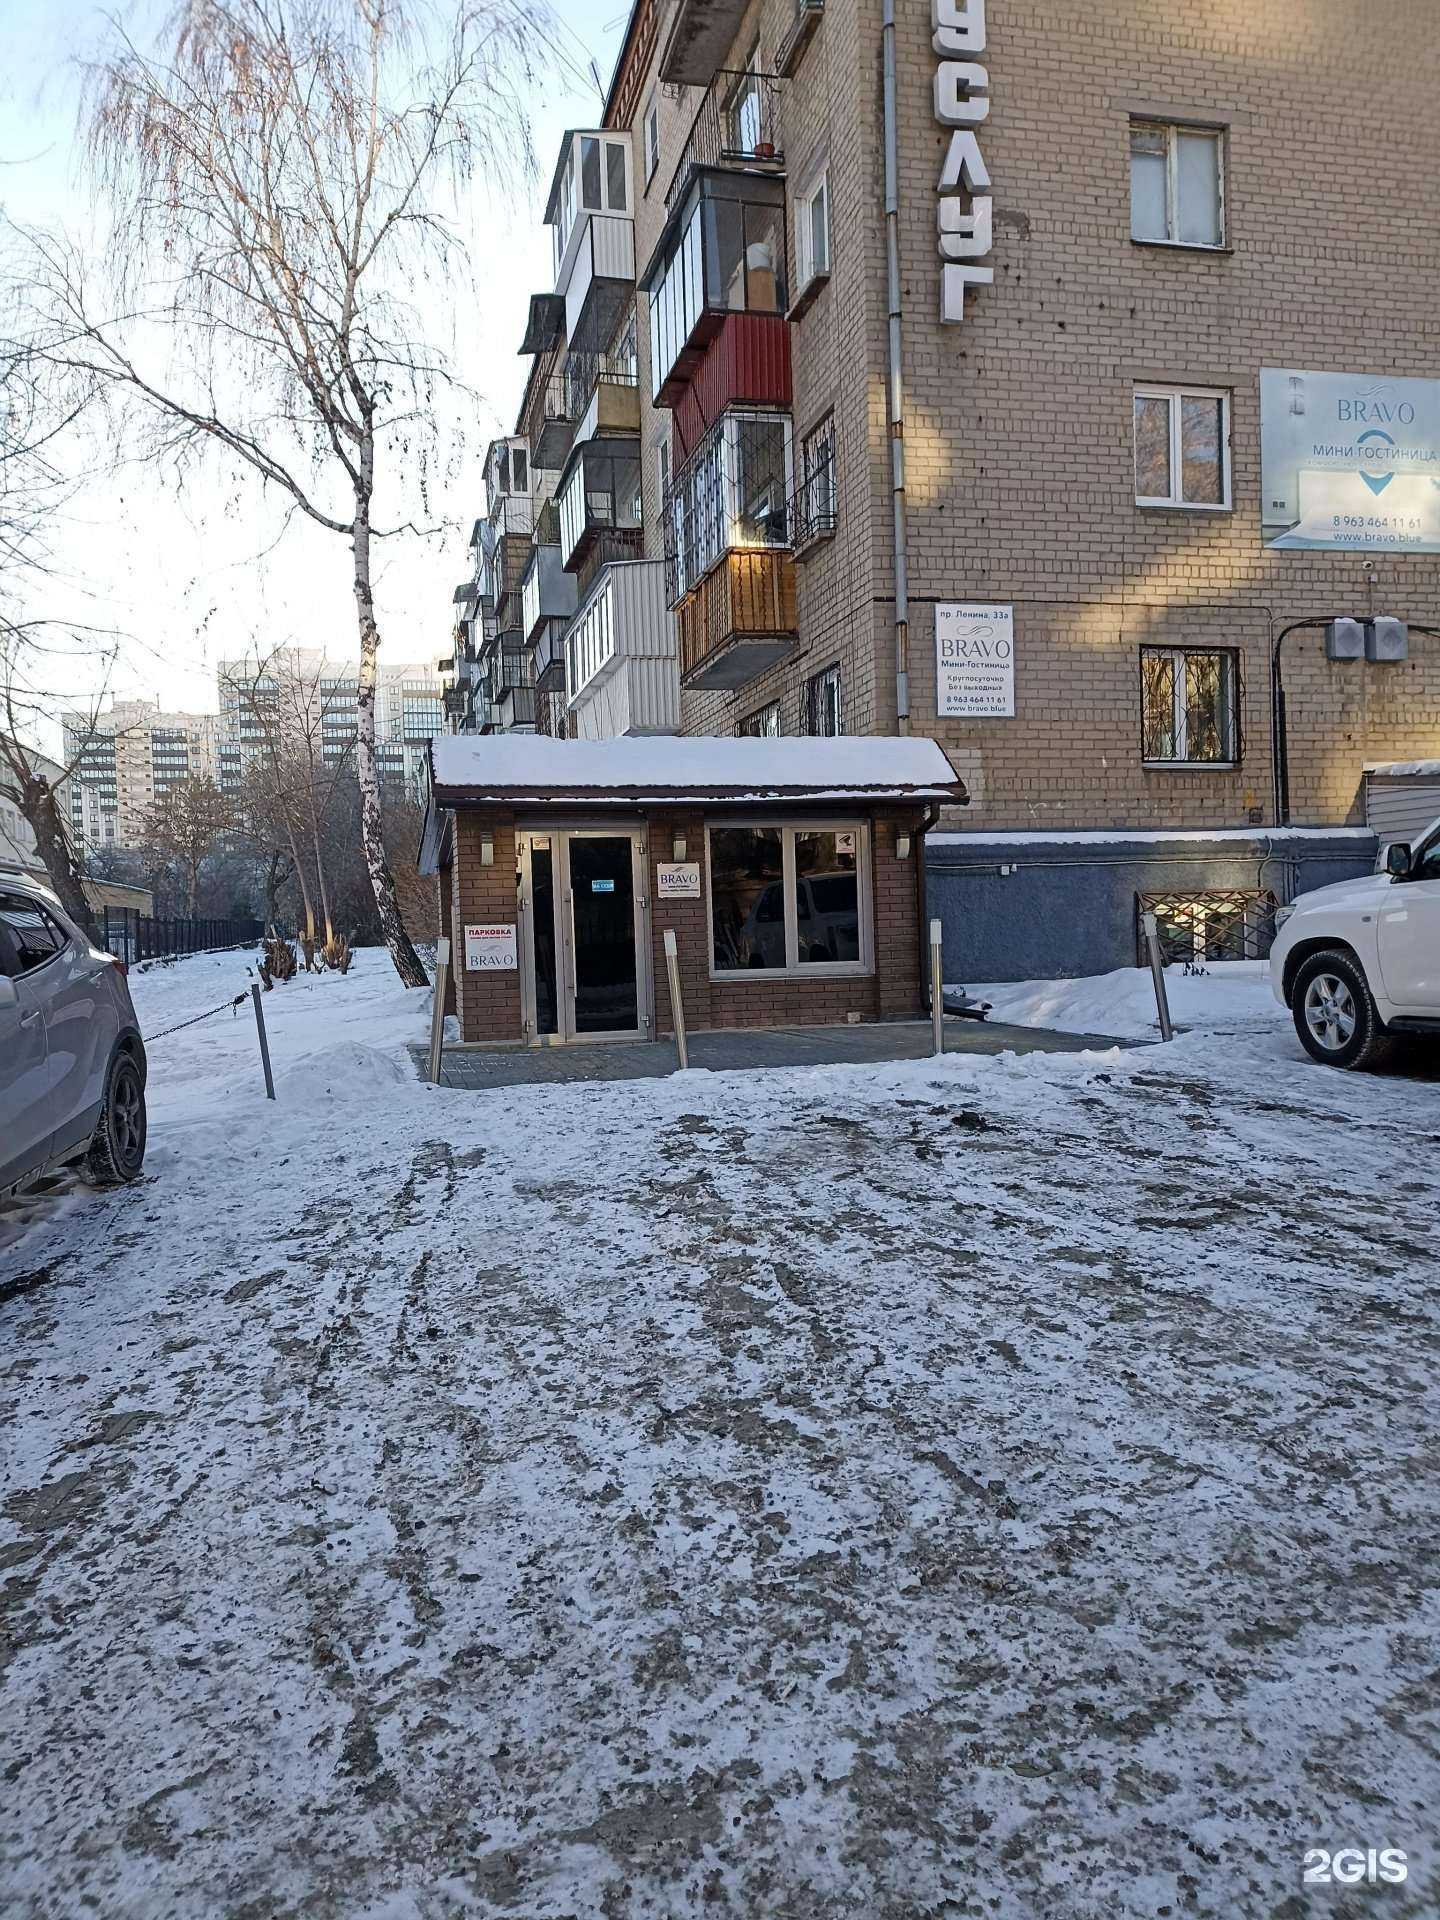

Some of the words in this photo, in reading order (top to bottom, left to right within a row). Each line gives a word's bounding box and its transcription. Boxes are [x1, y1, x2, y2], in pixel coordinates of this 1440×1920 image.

[1338, 399, 1415, 424] BRAVO
[1313, 444, 1353, 457] МИНИ
[1358, 446, 1438, 462] ГОСТИНИЦА
[1333, 516, 1340, 527] 8
[1343, 515, 1364, 528] 963
[1367, 517, 1388, 528] 464
[1393, 518, 1405, 529] 11
[1408, 518, 1422, 529] 61
[1333, 532, 1423, 543] www.bravo.blue
[941, 639, 1010, 658] BRAVO
[941, 660, 1010, 670] Мини-Гостиница
[947, 675, 1005, 683] Круглосуточно
[660, 874, 698, 884] BRAVO
[470, 954, 514, 967] BRAVO
